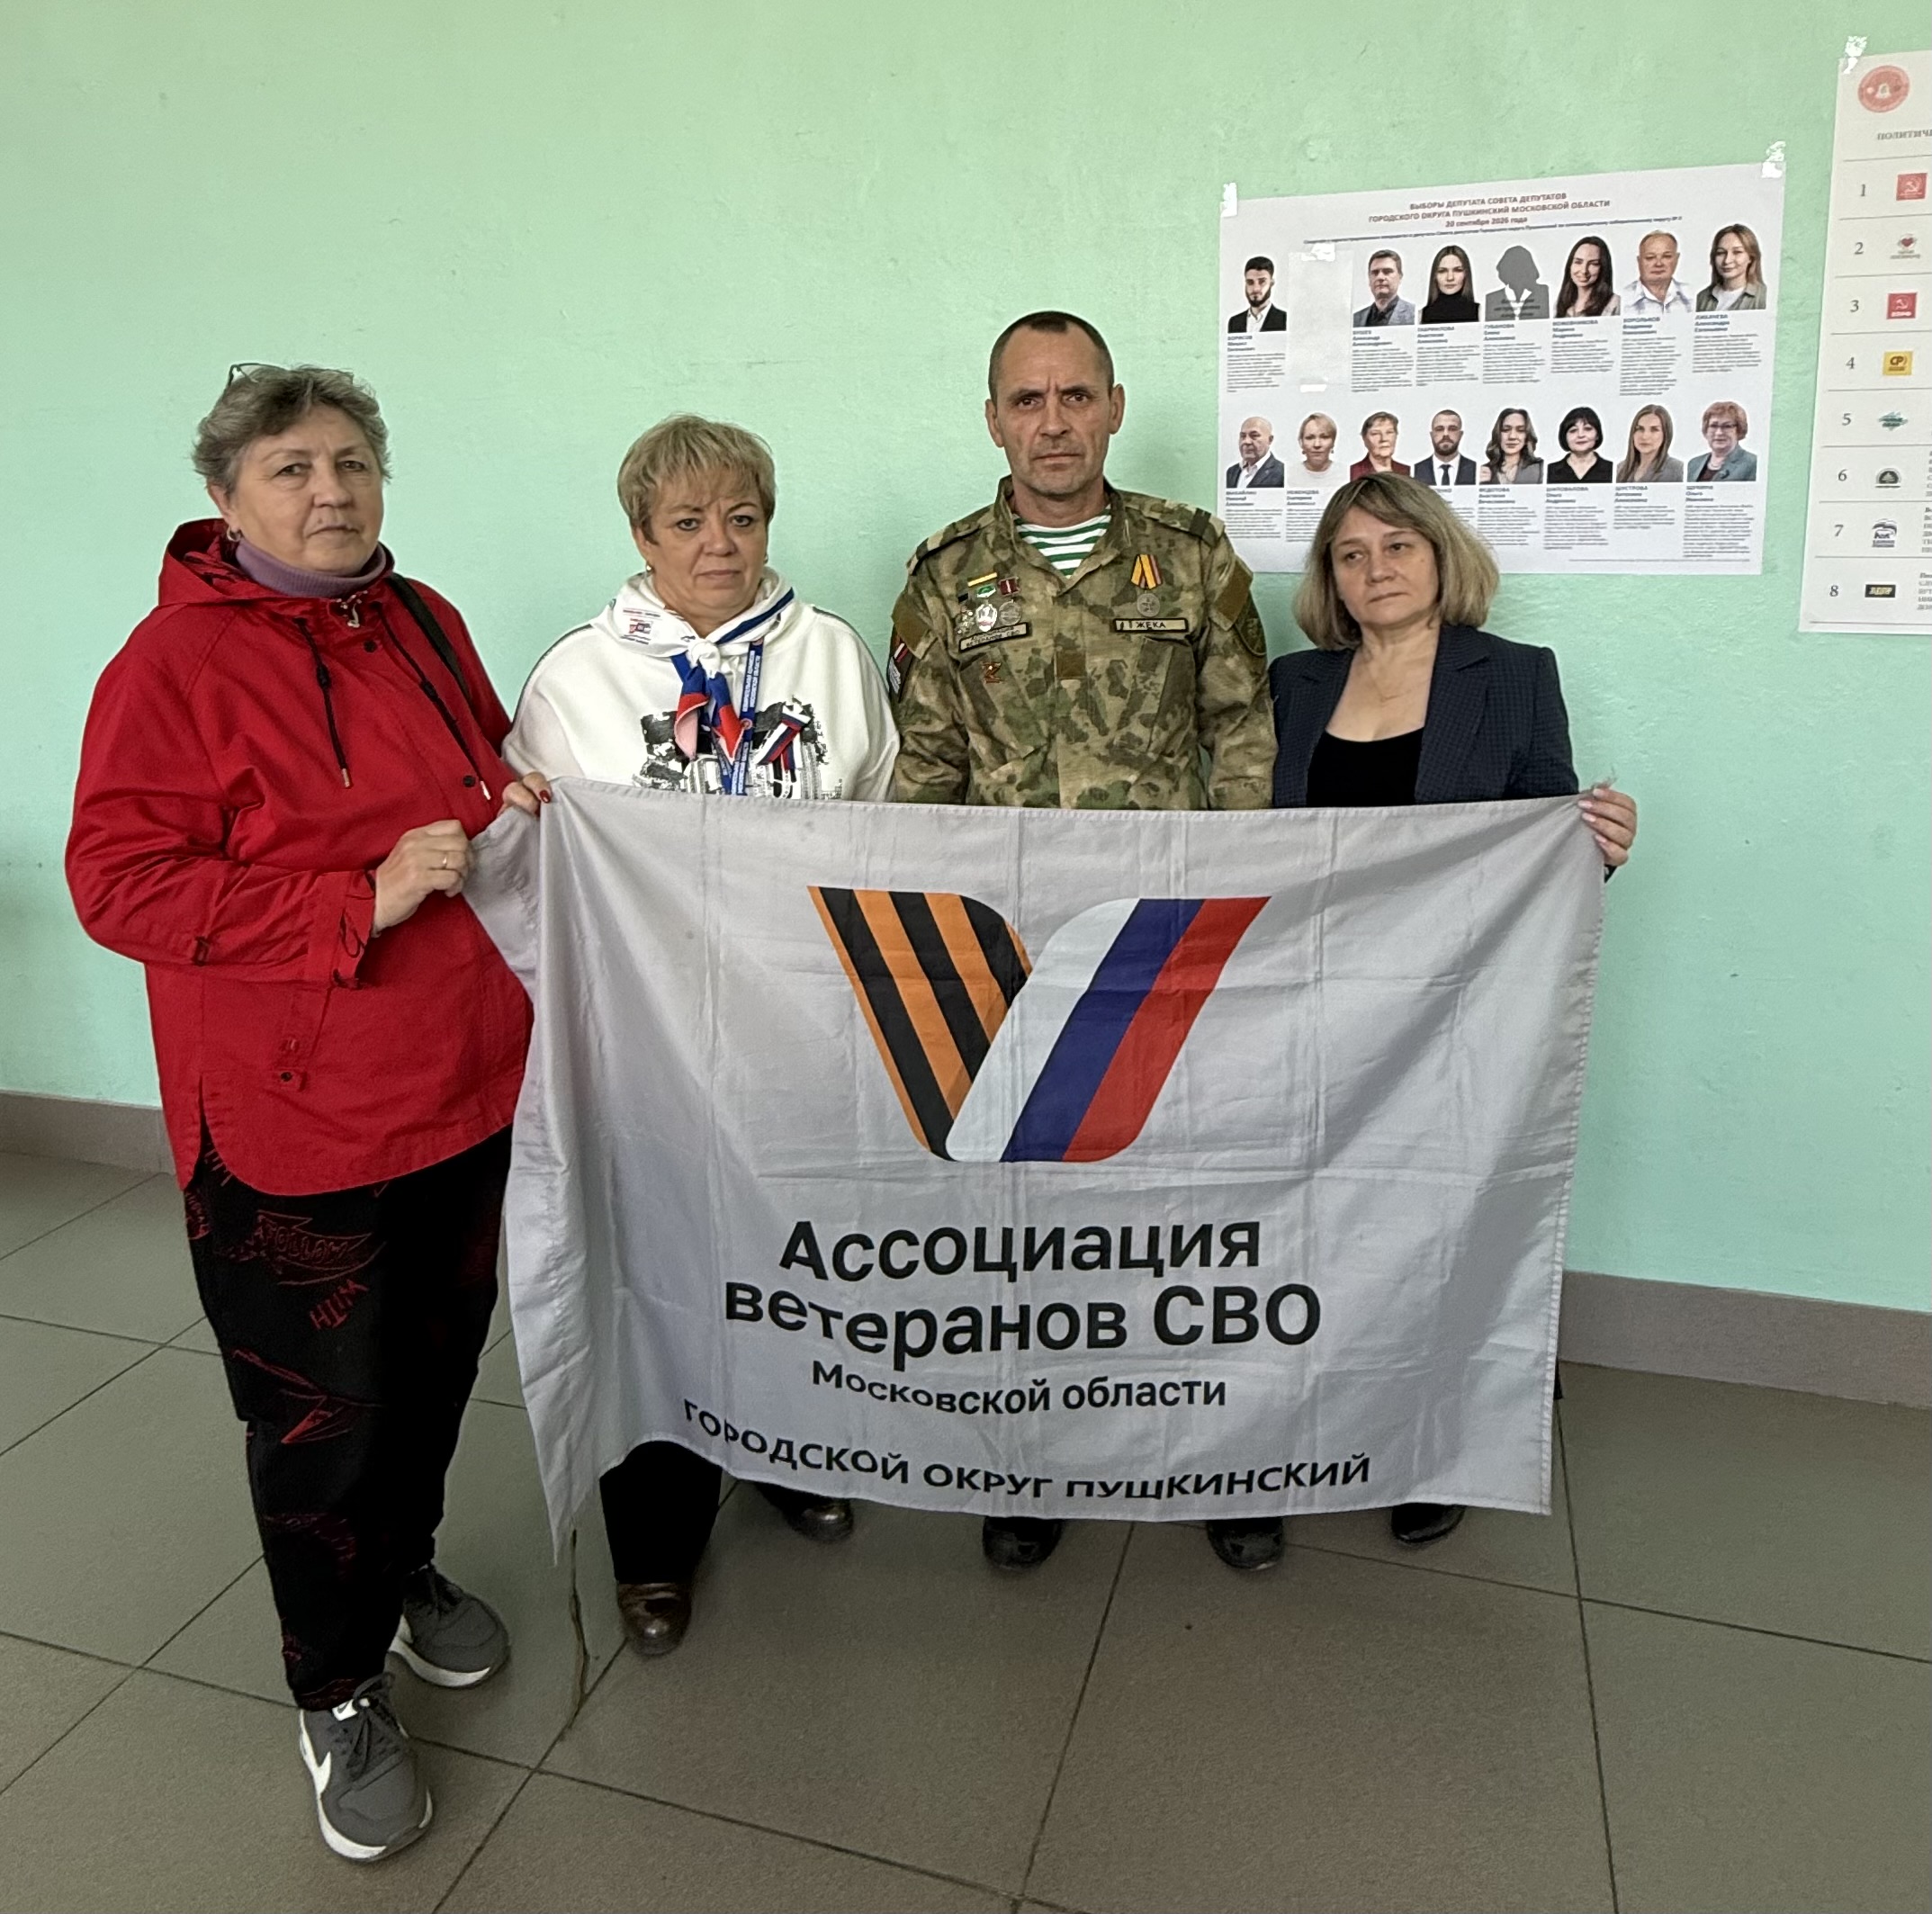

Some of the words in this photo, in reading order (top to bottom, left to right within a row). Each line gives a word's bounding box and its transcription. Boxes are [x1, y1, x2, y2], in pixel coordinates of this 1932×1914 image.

[1877, 129, 1932, 140] ПОЛИТИЧ
[1860, 184, 1866, 197] 1
[1446, 198, 1486, 208] ДЕПУТАТА
[1519, 193, 1567, 203] ДЕПУТАТОВ
[1369, 212, 1420, 222] ГОРОДСКОГО
[1422, 211, 1451, 220] ОКРУГА
[1452, 206, 1510, 217] ПУШКИНСКИЙ
[1511, 202, 1569, 212] МОСКОВСКОЙ
[1571, 200, 1611, 209] ОБЛАСТИ
[1854, 242, 1865, 255] 2
[1850, 300, 1860, 312] 3
[1846, 356, 1856, 370] 4
[1842, 413, 1852, 427] 5
[1838, 469, 1847, 481] 6
[1834, 525, 1844, 537] 7
[1829, 585, 1839, 598] 8
[1136, 621, 1166, 629] ЖЕКА
[778, 1220, 1260, 1282] Ассоциация
[725, 1281, 1128, 1372] ветеранов
[1154, 1283, 1321, 1346] СВО
[813, 1360, 1050, 1415] Московской
[1062, 1376, 1226, 1410] области
[683, 1398, 909, 1484] ГОРОДСКОЙ
[923, 1463, 1053, 1498] ОКРУГ
[1065, 1451, 1370, 1500] ПУШКИНСКИЙ
